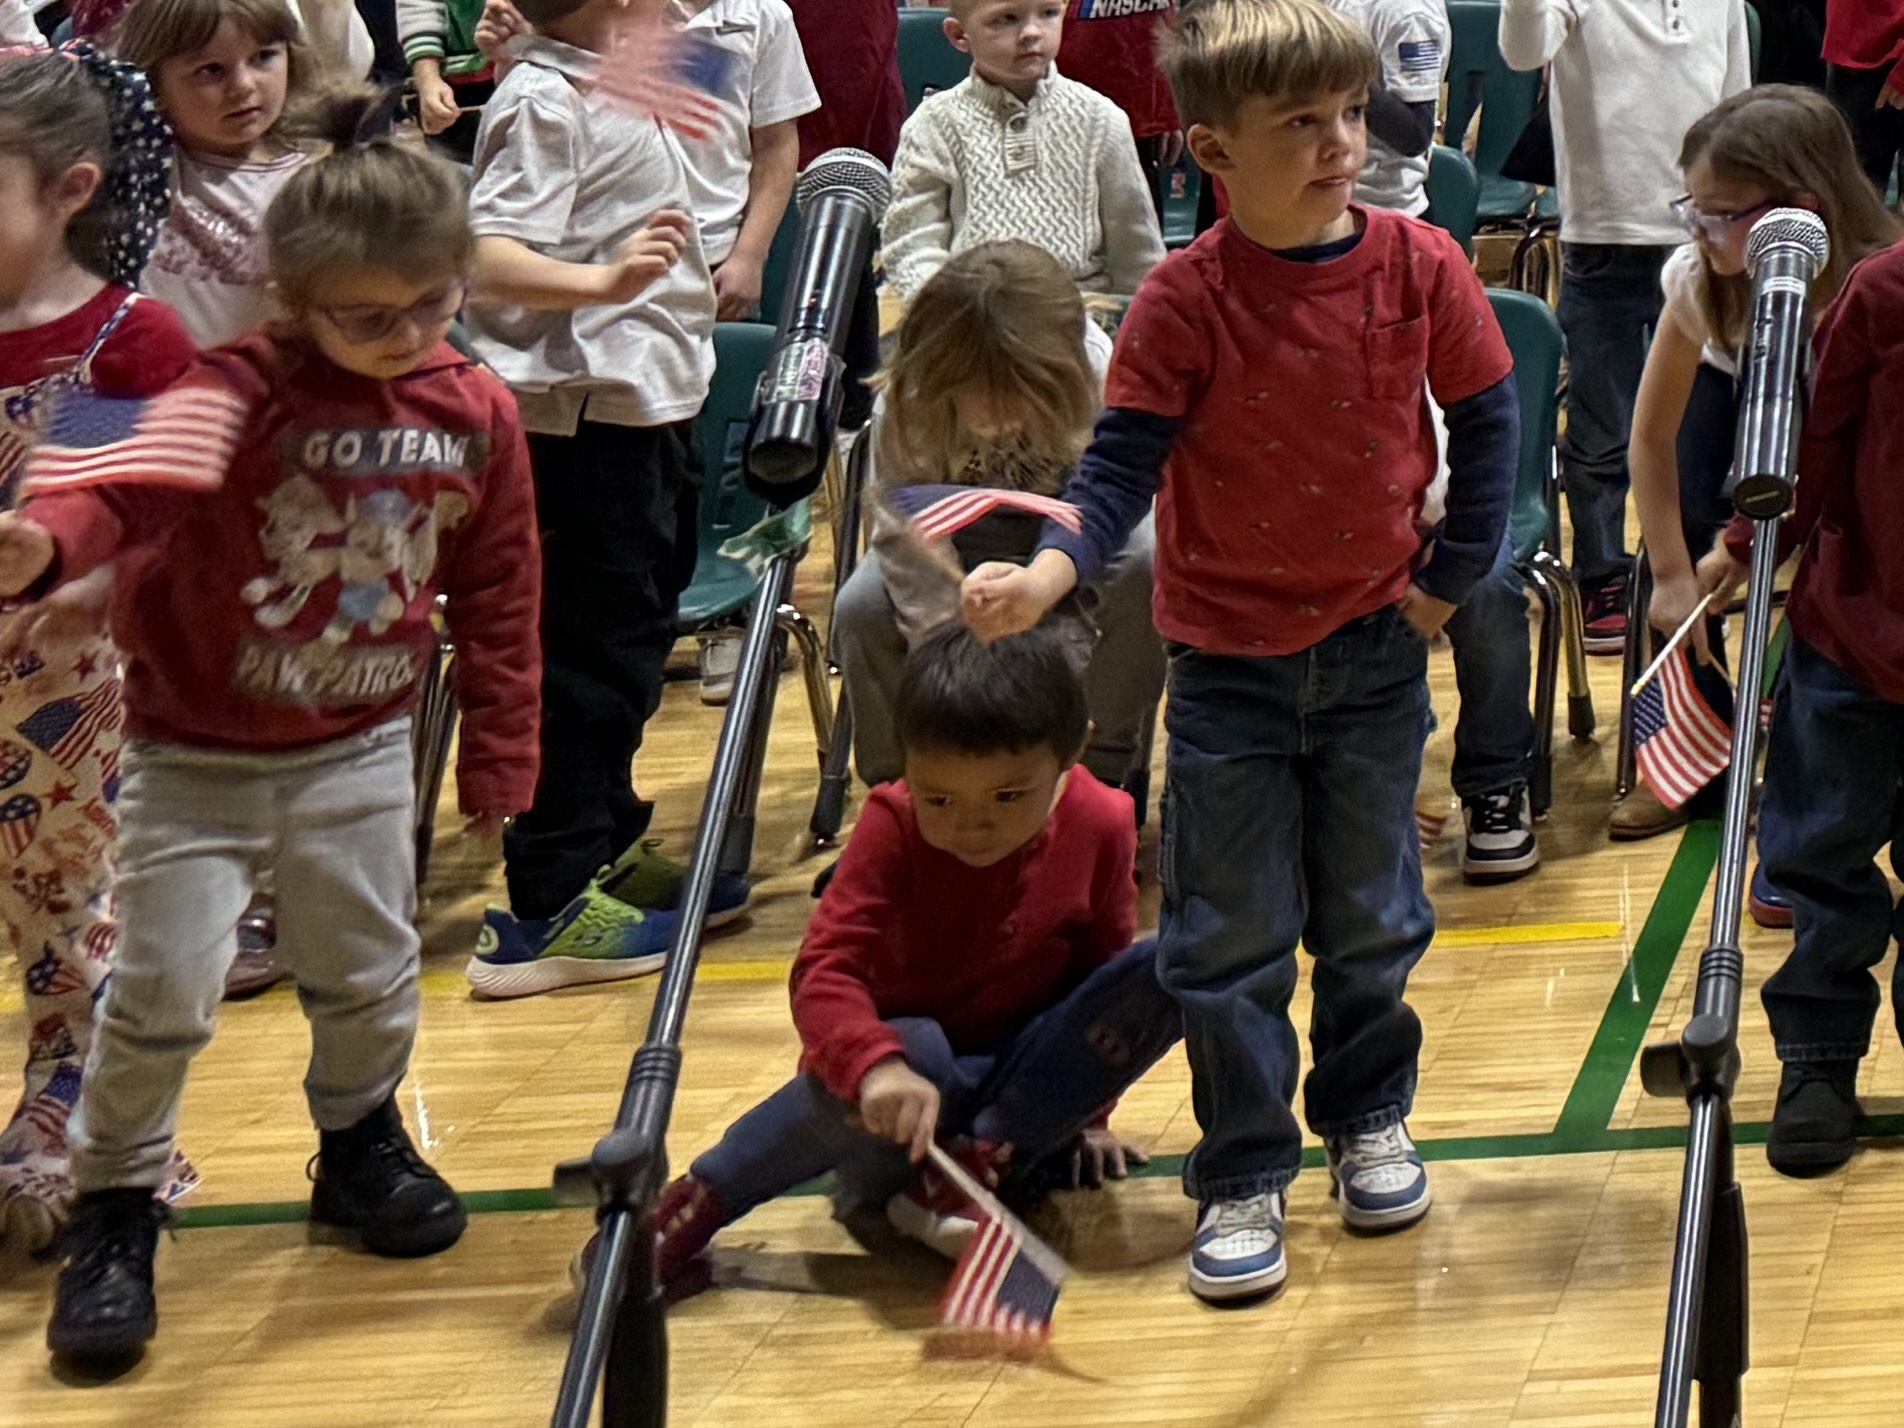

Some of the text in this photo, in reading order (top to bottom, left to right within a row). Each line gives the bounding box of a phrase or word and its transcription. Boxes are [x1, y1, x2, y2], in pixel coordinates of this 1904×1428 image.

[303, 428, 470, 468] GO TEAM
[317, 650, 416, 696] PATRO
